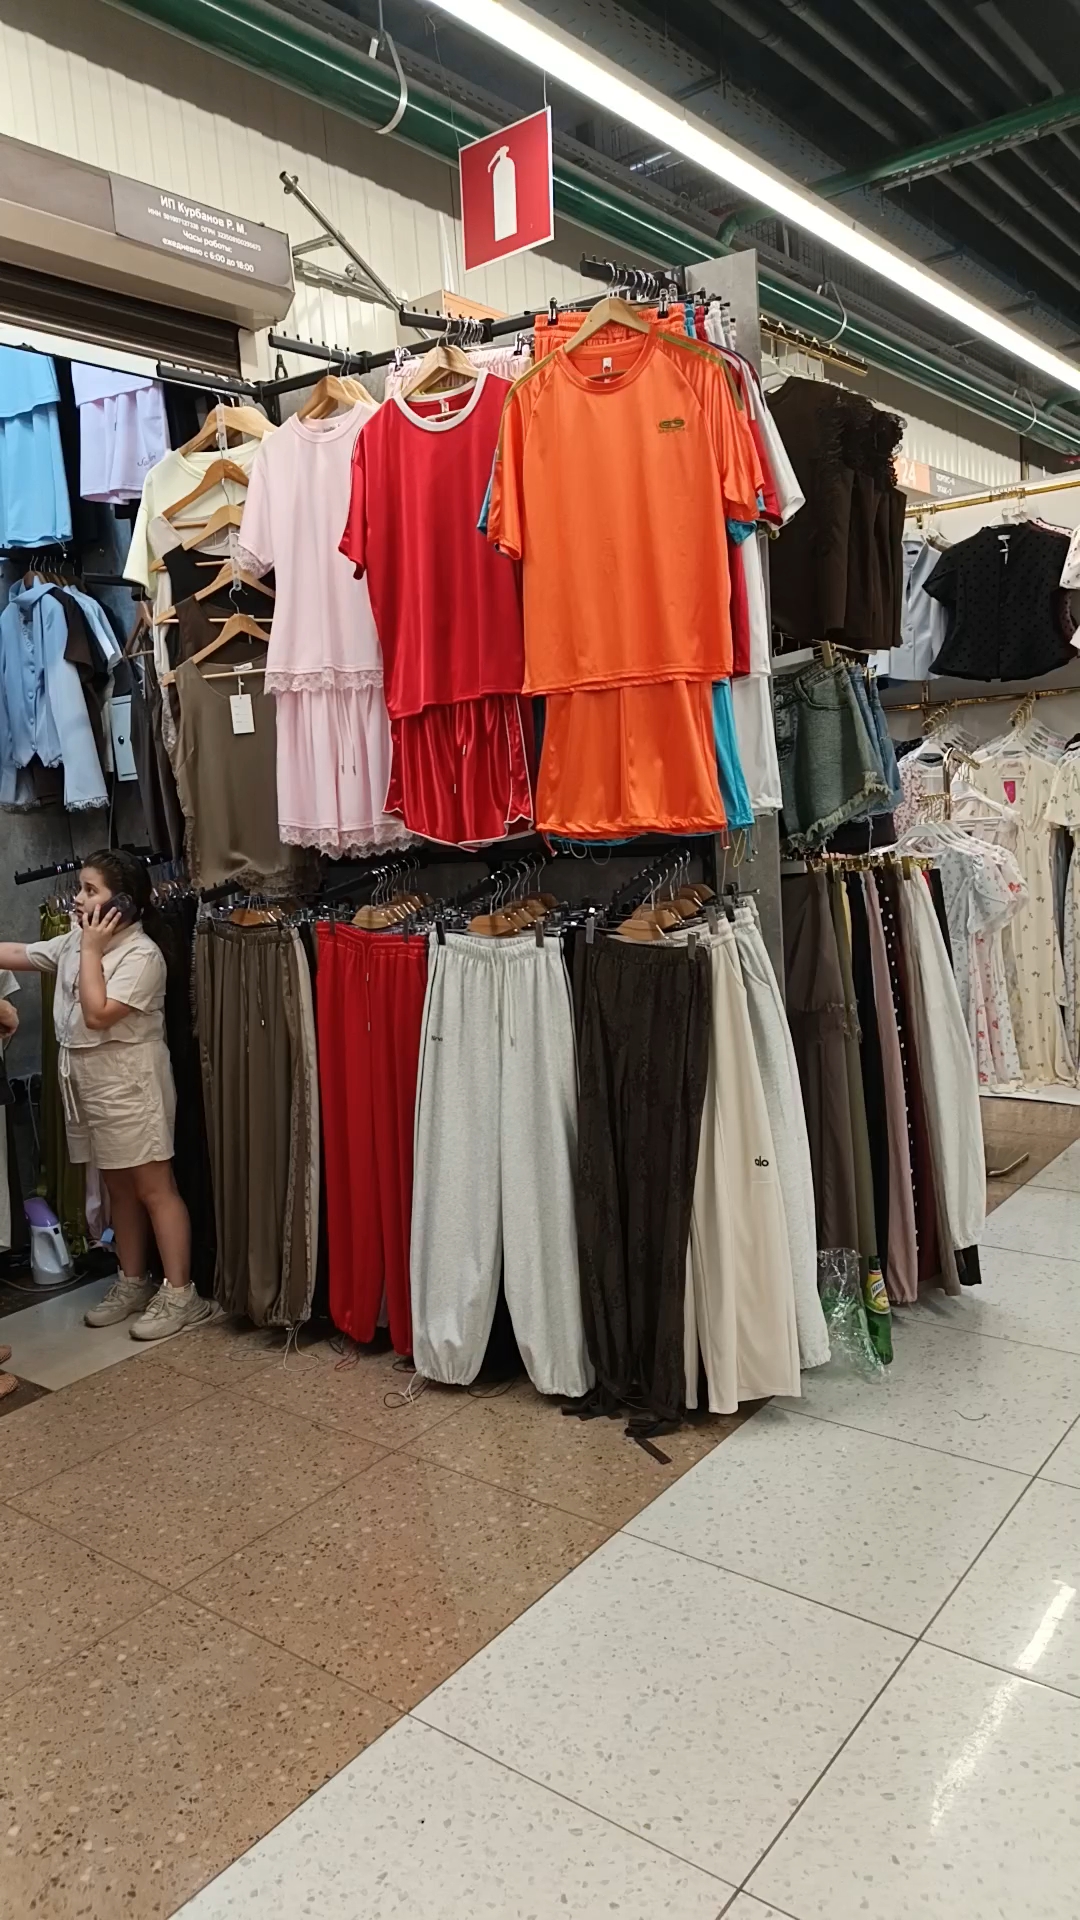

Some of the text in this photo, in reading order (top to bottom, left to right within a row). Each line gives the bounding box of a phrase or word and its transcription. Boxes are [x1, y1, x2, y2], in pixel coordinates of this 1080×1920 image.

[147, 206, 162, 218] ИНН
[200, 225, 216, 236] ОГРН
[160, 195, 248, 235] ИП Курбанов Р. М.
[162, 237, 203, 256] ежедневно
[209, 251, 226, 263] 6:00
[226, 258, 236, 267] до
[236, 260, 255, 273] 18:00
[182, 229, 233, 253] Часы работы:
[900, 457, 917, 487] 24
